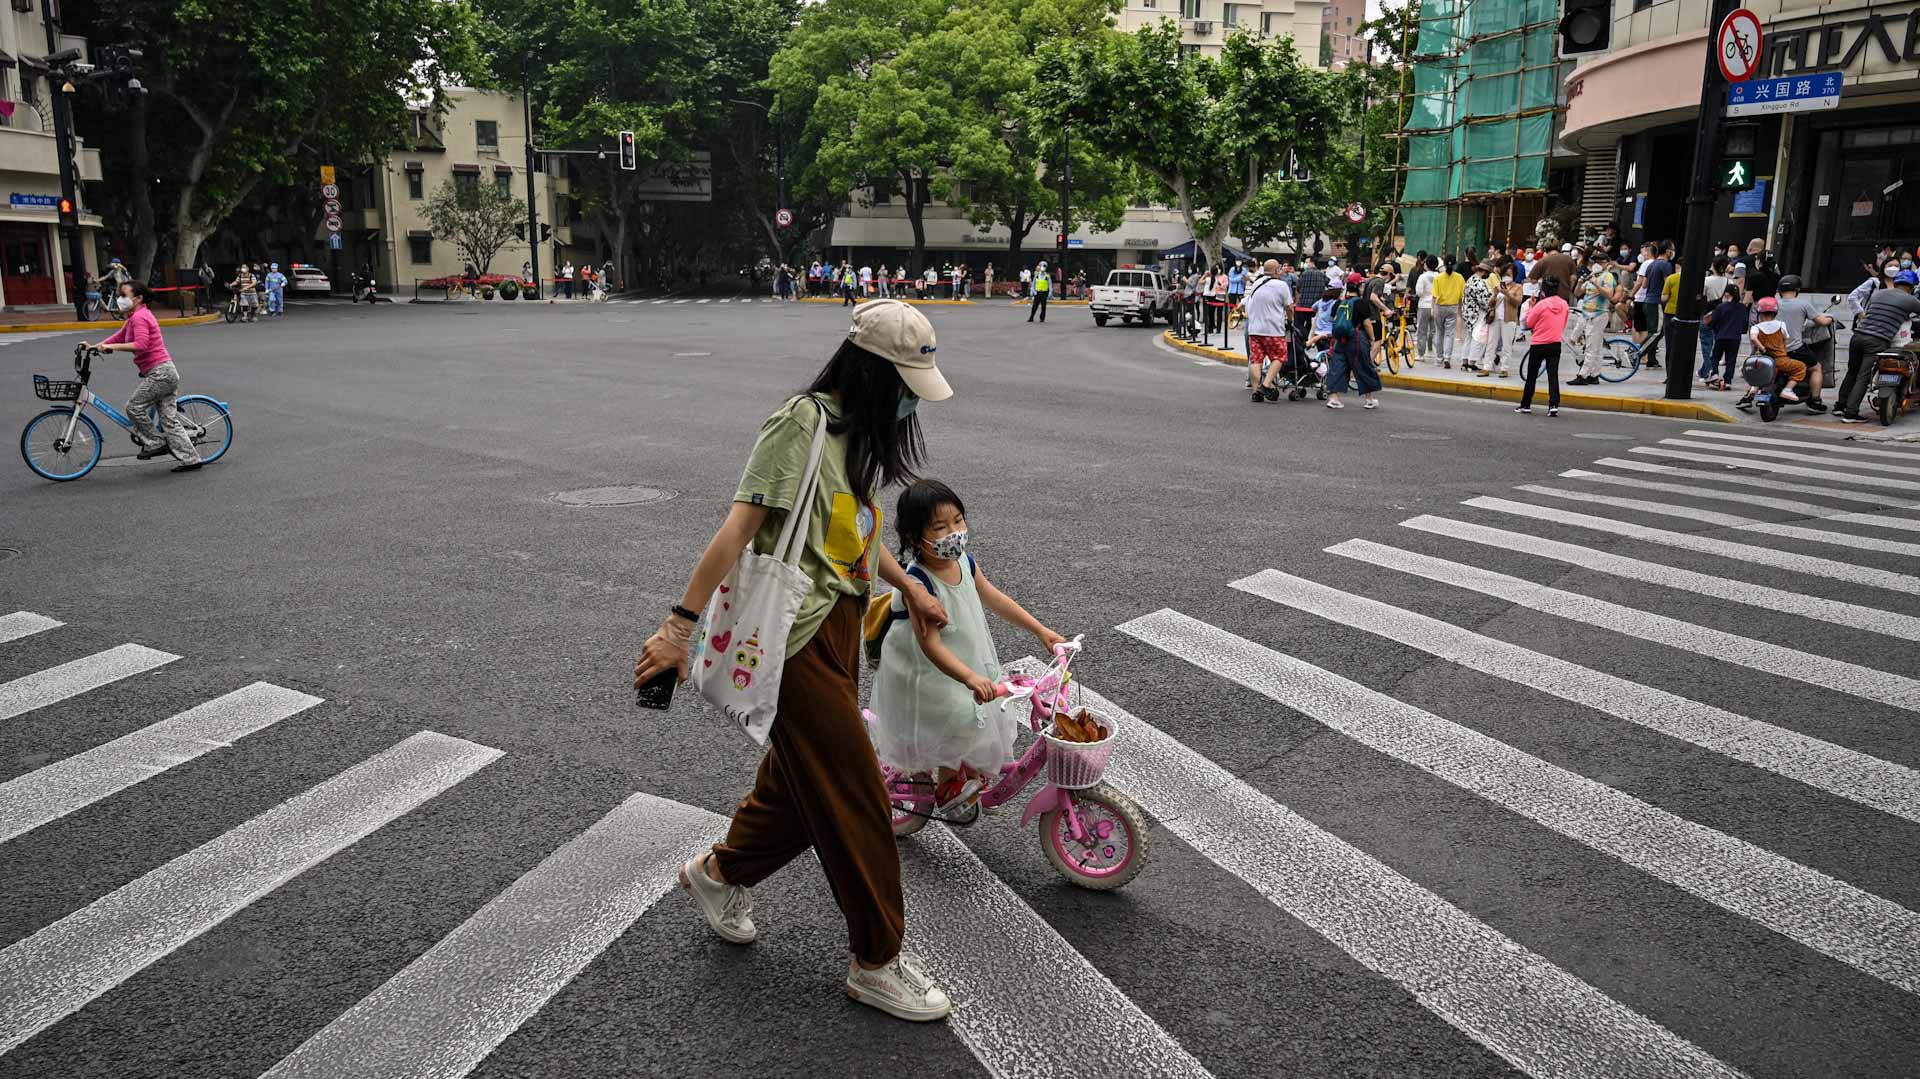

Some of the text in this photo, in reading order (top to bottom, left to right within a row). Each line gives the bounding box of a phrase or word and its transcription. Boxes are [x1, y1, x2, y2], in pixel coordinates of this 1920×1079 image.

[1825, 77, 1835, 87] 北
[1755, 79, 1811, 100] 兴国路
[1821, 87, 1835, 95] 370
[1760, 103, 1787, 111] Xingguo
[1823, 98, 1831, 107] N
[1625, 161, 1636, 190] M
